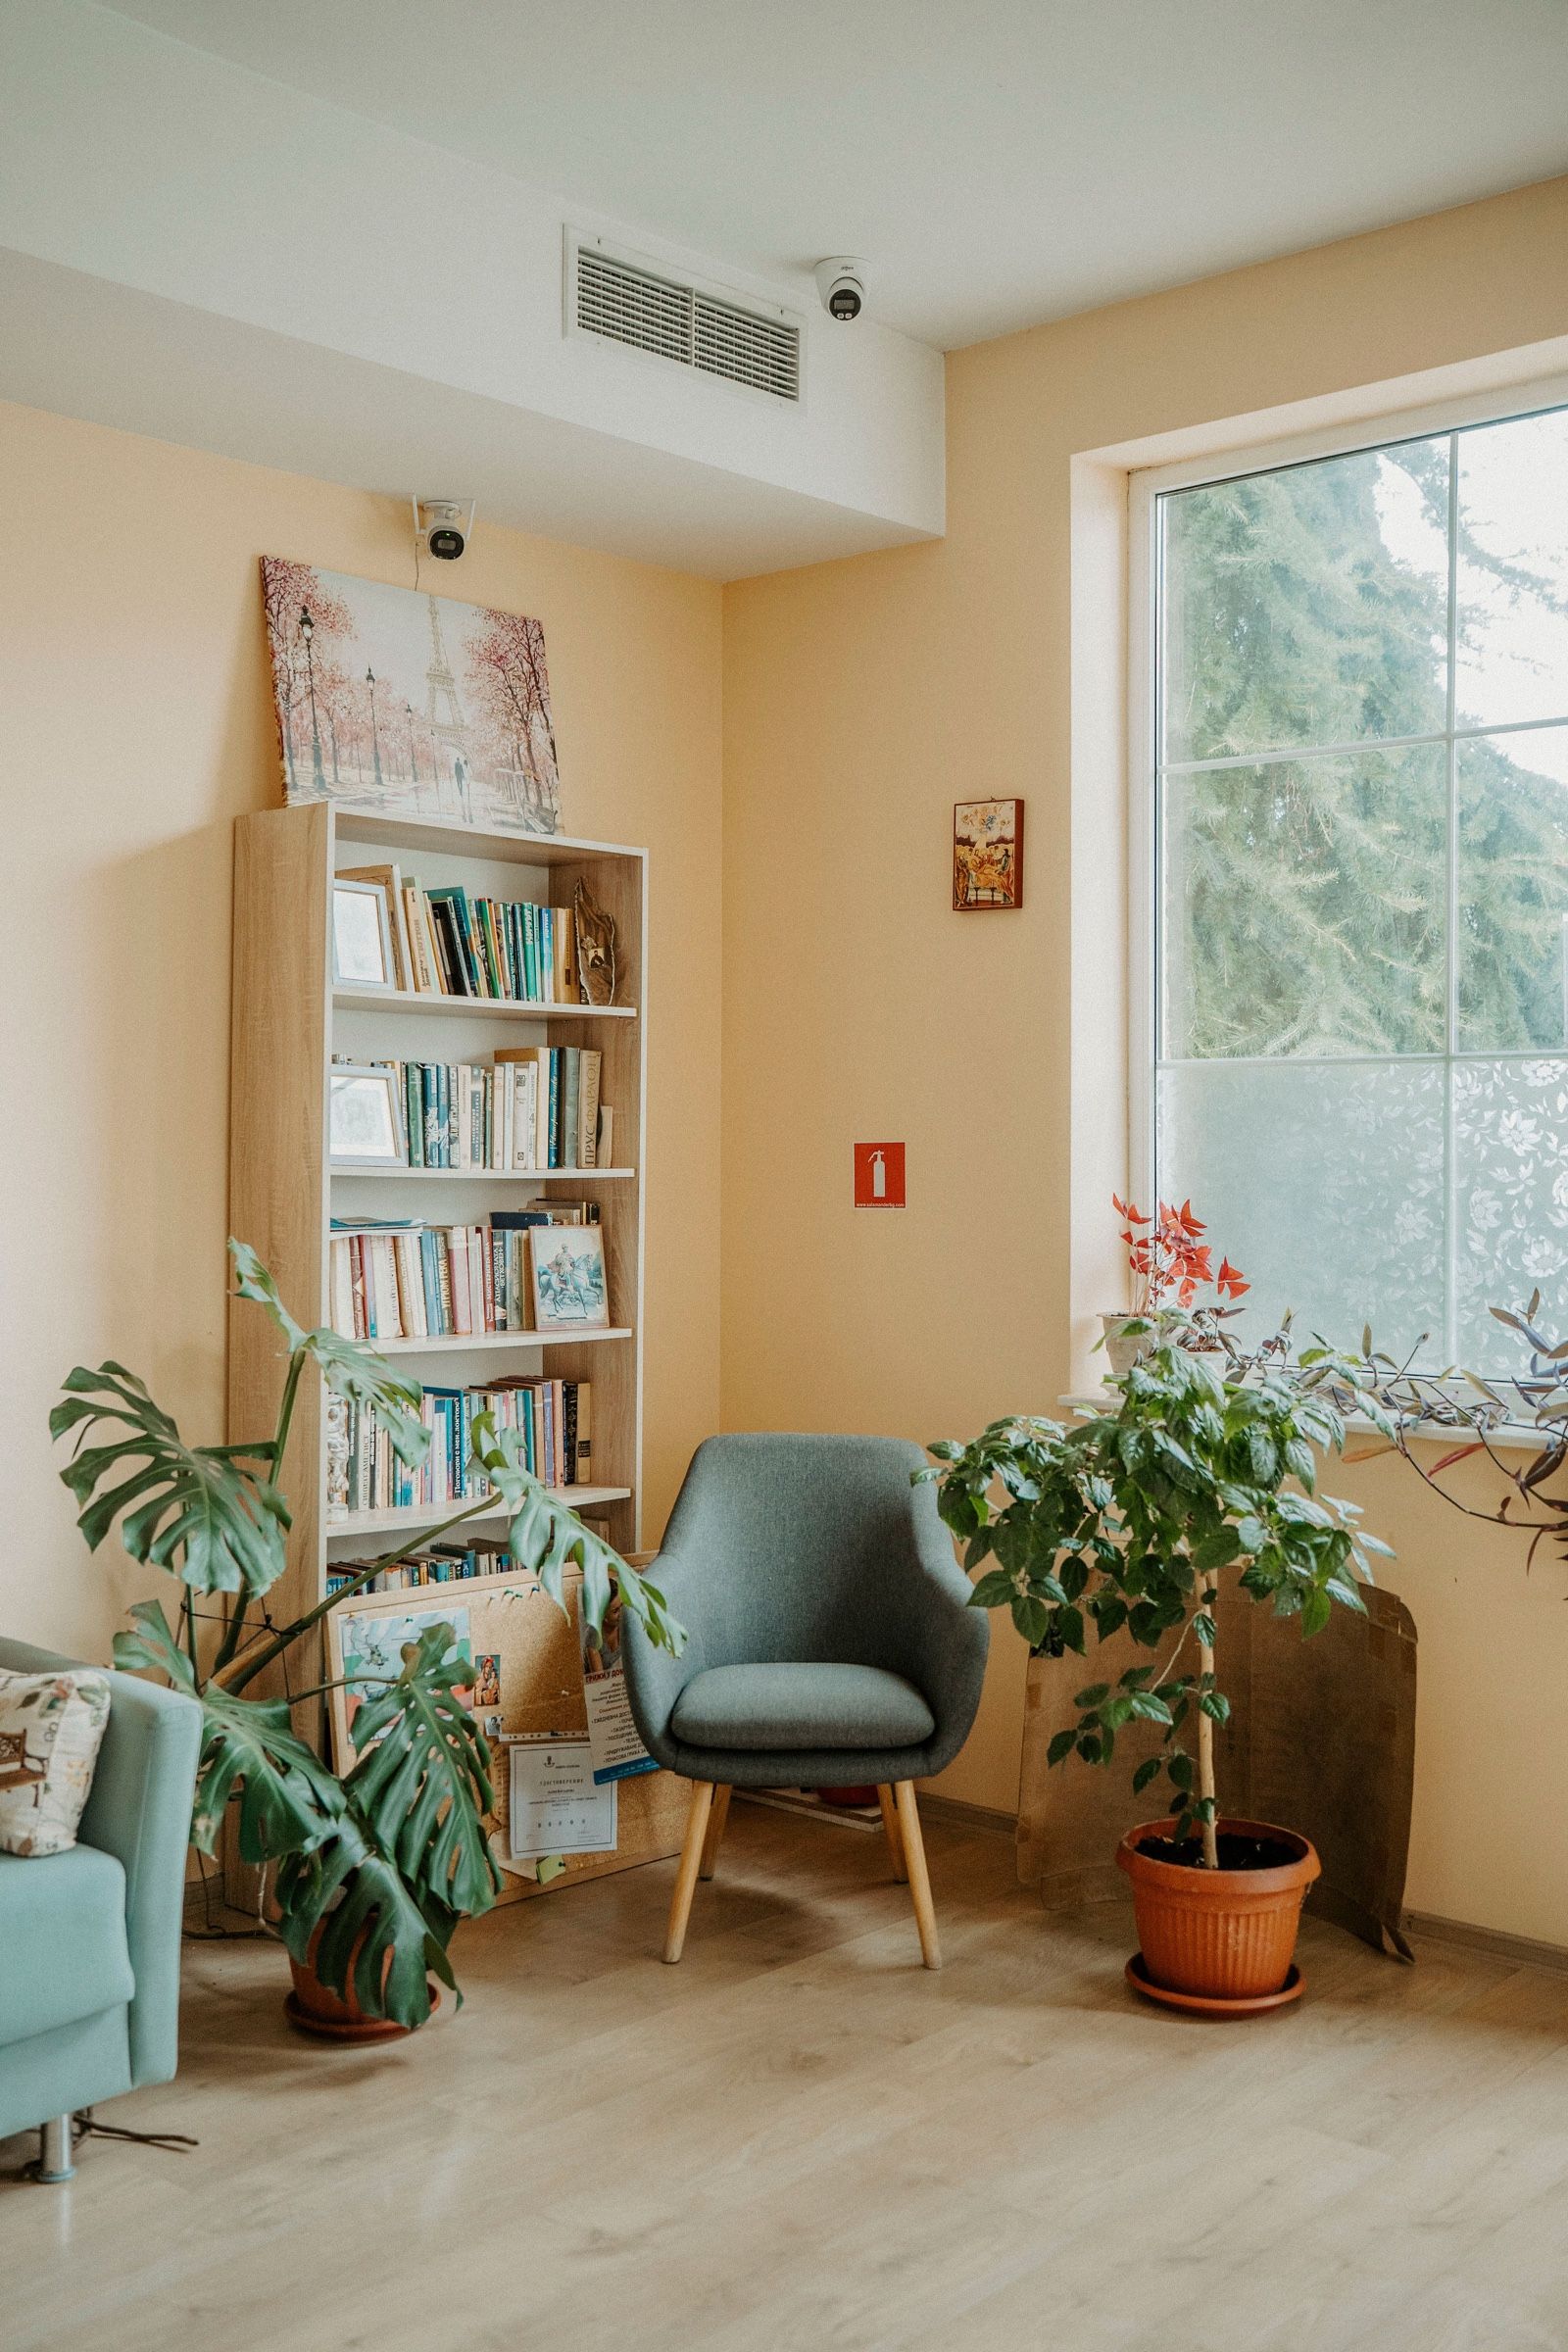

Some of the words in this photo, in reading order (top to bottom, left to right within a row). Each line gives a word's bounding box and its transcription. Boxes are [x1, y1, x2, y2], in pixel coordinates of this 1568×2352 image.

[585, 1054, 597, 1122] ФАРАОН
[549, 1102, 559, 1146] Екатерина
[584, 1125, 596, 1164] ПРУС
[438, 1258, 449, 1279] РЕКА
[440, 1280, 451, 1309] УГРЮМ
[585, 1673, 606, 1683] ГРИЖИ
